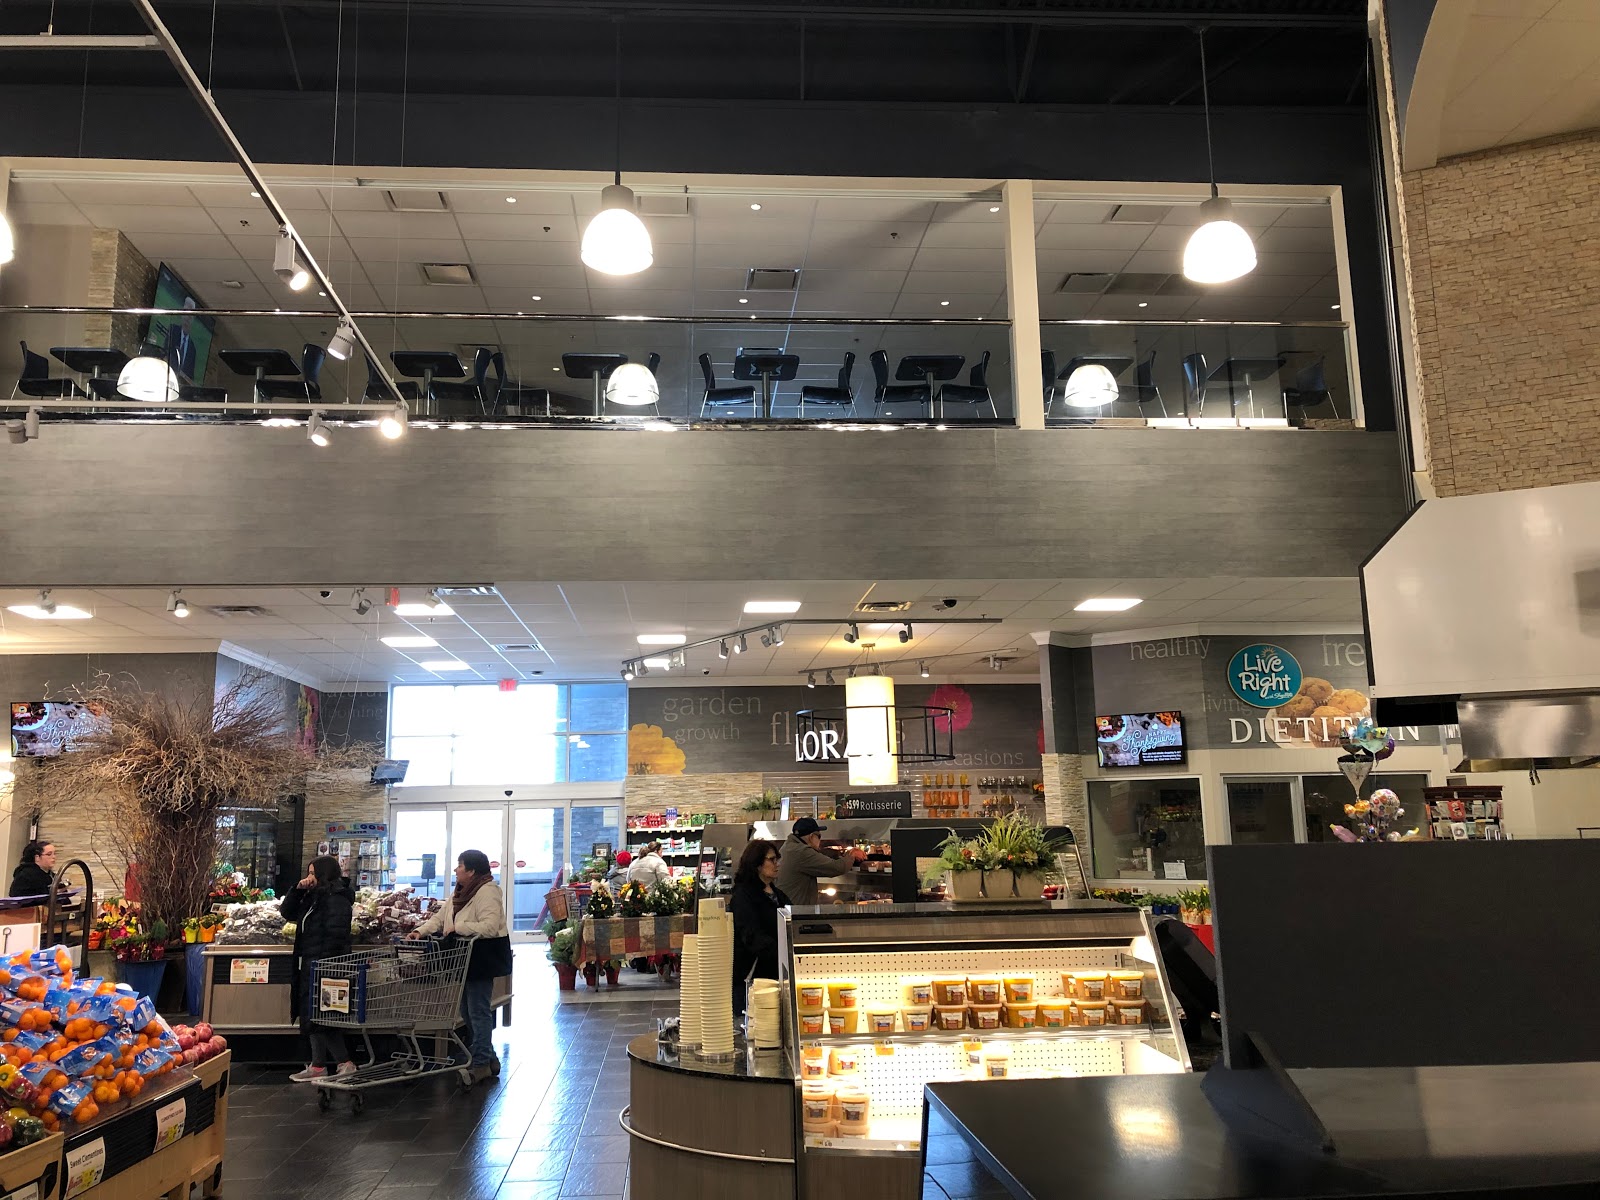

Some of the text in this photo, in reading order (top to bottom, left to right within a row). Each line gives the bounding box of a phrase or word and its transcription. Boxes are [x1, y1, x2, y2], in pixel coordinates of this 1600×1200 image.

[1130, 637, 1211, 660] healthy
[1244, 653, 1285, 673] Live
[1238, 671, 1291, 698] Right
[662, 689, 761, 721] garden
[674, 722, 740, 744] growth
[1228, 717, 1420, 743] DIETITN
[1121, 729, 1177, 757] Thanksgiving
[932, 748, 1024, 766] occasions
[860, 800, 902, 811] Rotisserie
